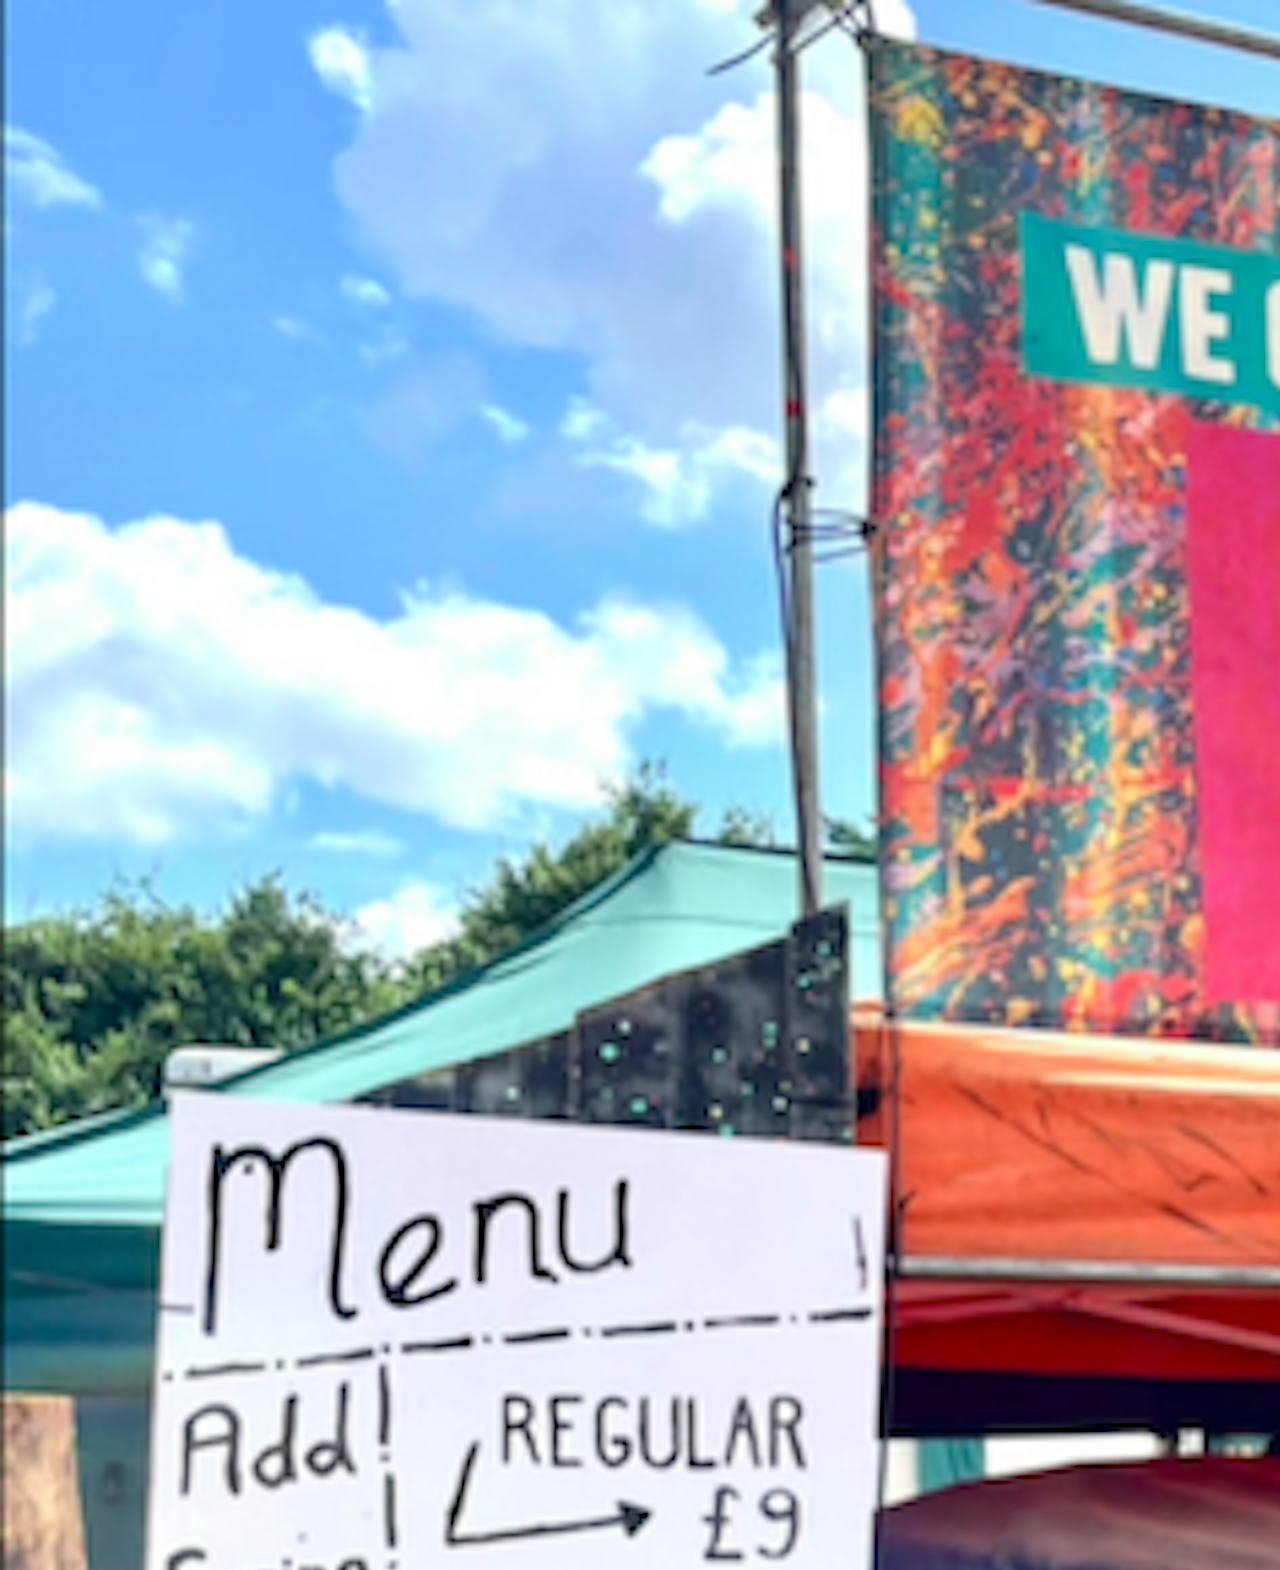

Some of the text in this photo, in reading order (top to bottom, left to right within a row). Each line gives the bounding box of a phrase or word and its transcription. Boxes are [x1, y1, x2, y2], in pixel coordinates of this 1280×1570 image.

[1064, 246, 1234, 384] WE
[201, 1136, 634, 1336] Menu
[180, 1382, 357, 1498] Add
[499, 1394, 808, 1470] REGULAR
[702, 1486, 802, 1563] £9
